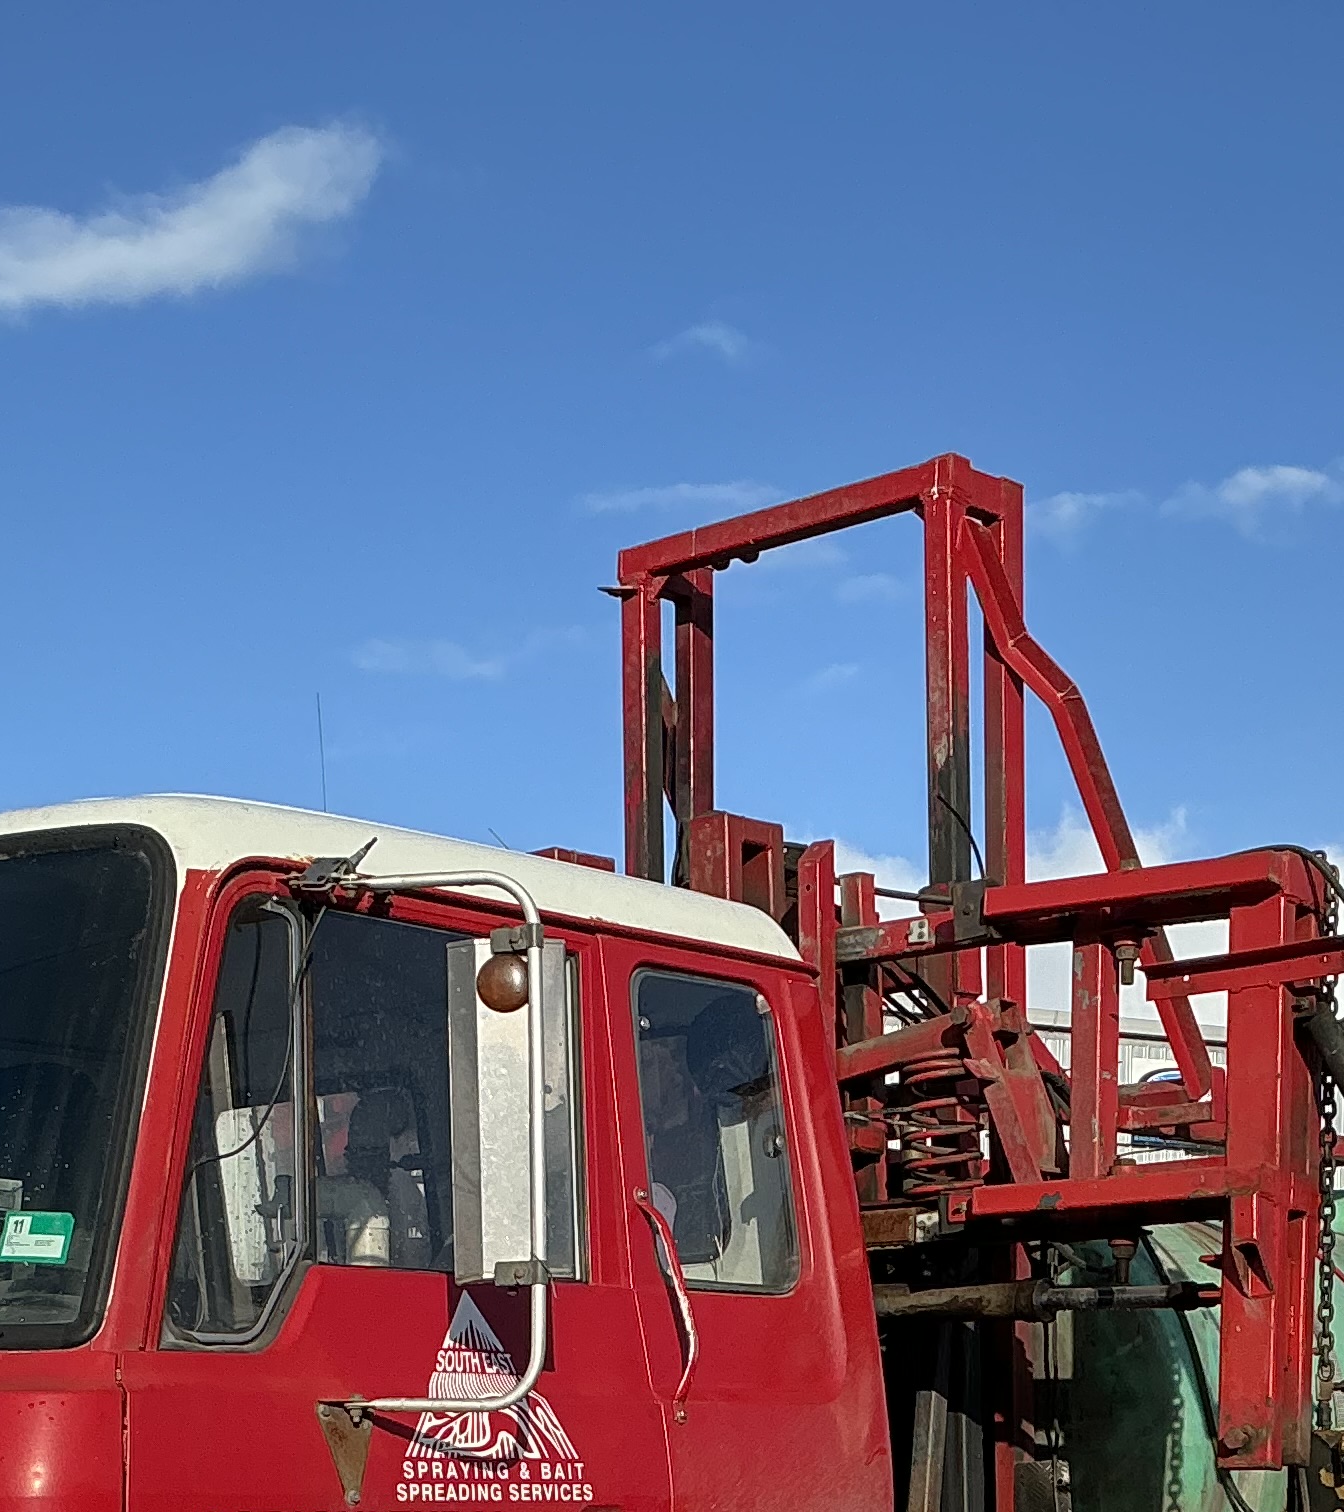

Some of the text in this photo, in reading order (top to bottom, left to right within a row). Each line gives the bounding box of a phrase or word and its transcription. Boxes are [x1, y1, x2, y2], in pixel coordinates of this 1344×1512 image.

[13, 1219, 25, 1234] 11
[435, 1350, 517, 1375] SOUTH EAST
[402, 1461, 585, 1480] SPRAYING & BAIT
[396, 1483, 593, 1501] SPREADING SERVICES
